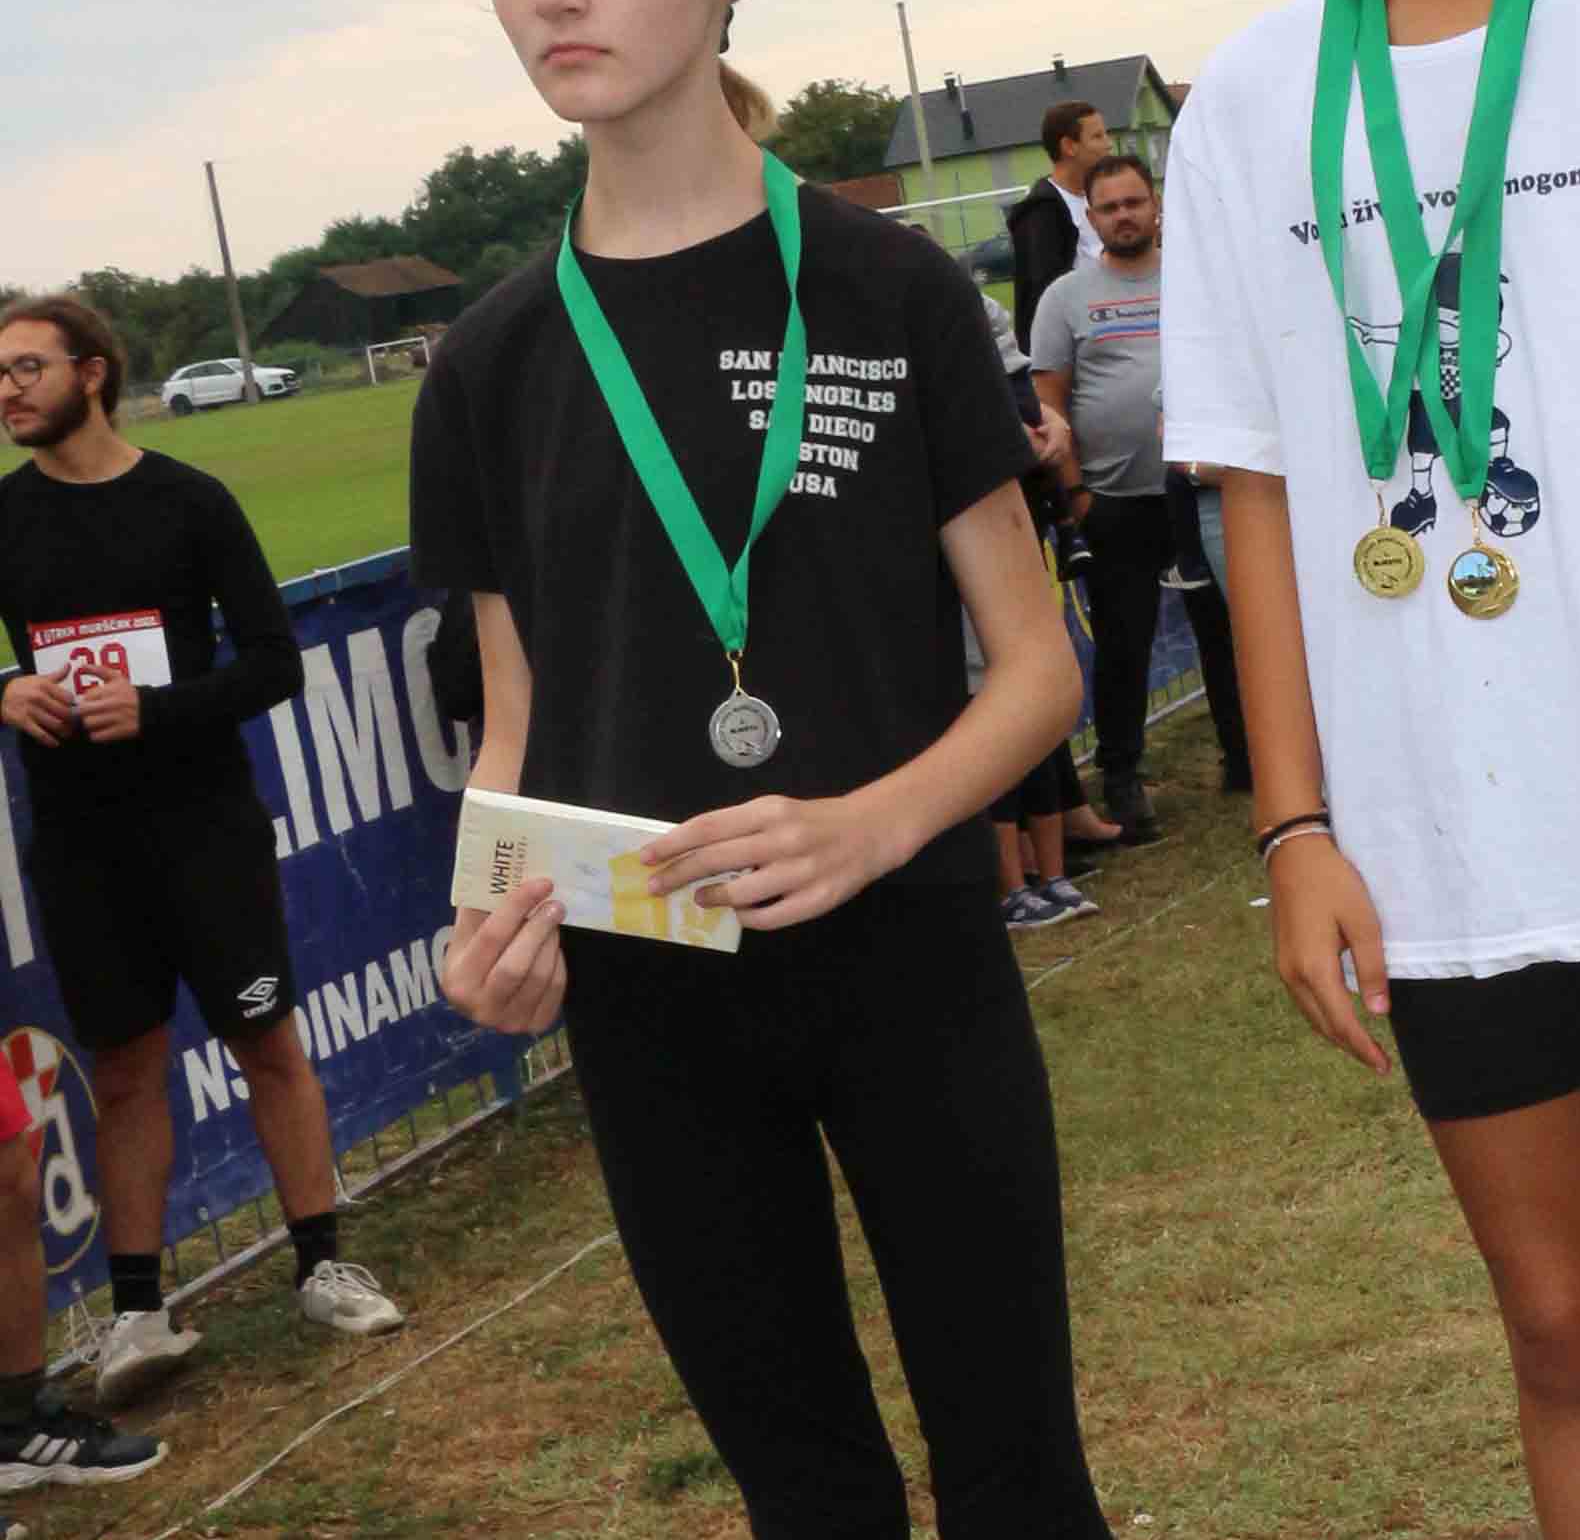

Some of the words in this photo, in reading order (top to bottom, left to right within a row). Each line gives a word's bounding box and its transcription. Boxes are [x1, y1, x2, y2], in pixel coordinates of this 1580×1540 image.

[719, 349, 772, 371] SAN
[778, 351, 908, 381] ANCISCO
[731, 380, 777, 401] LOS
[804, 384, 896, 413] NGELES
[808, 414, 875, 443] DIEGO
[798, 442, 859, 471] STON
[788, 473, 838, 499] USA
[489, 838, 515, 895] WHITE
